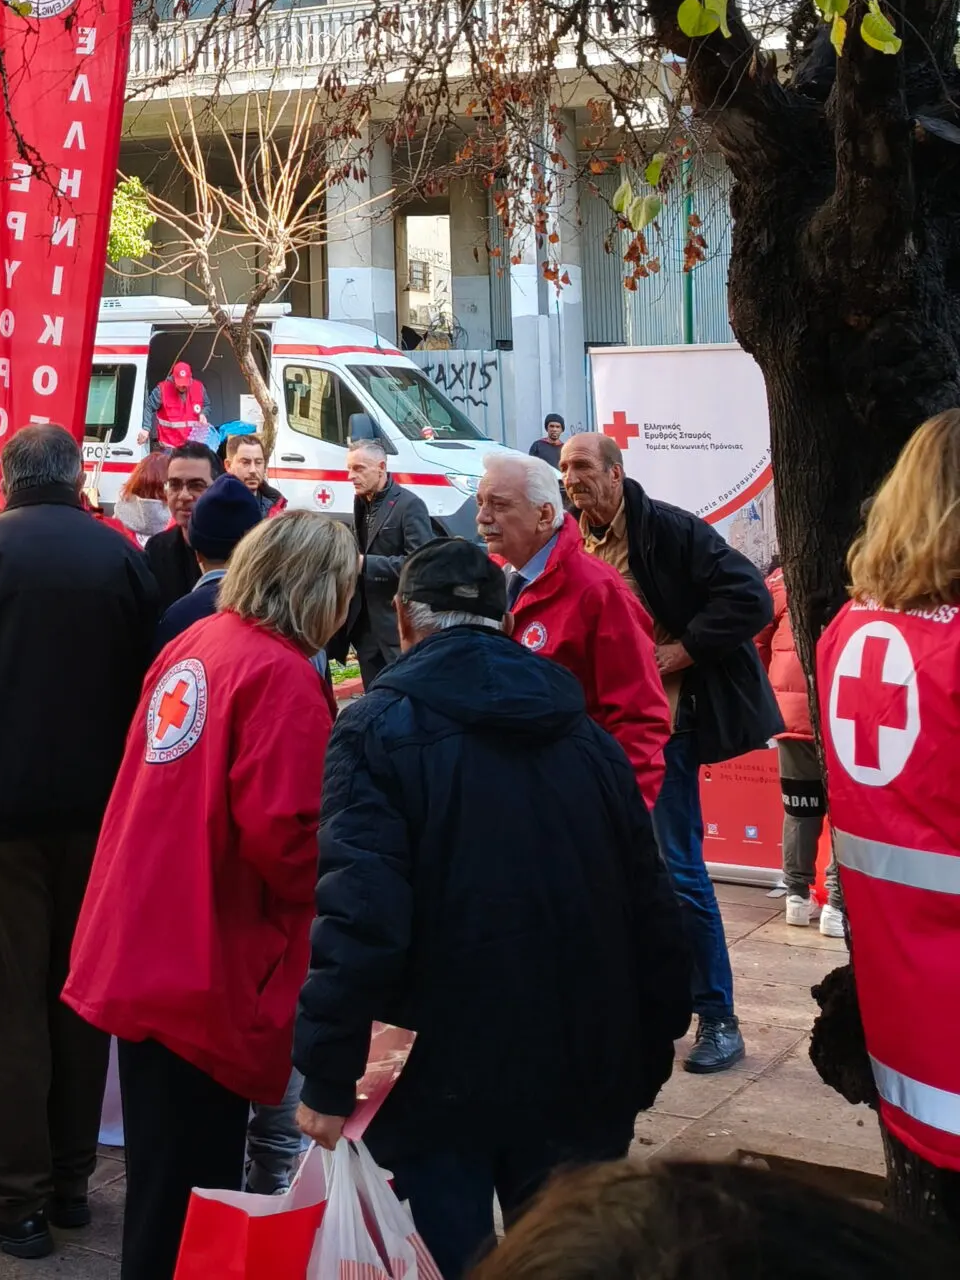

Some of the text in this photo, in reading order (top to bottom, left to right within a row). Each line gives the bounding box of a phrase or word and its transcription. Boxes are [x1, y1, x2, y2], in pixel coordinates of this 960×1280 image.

[644, 422, 681, 431] Ελληνικός
[644, 431, 711, 440] Ερυθρός Σταυρός
[158, 740, 190, 761] CROSS
